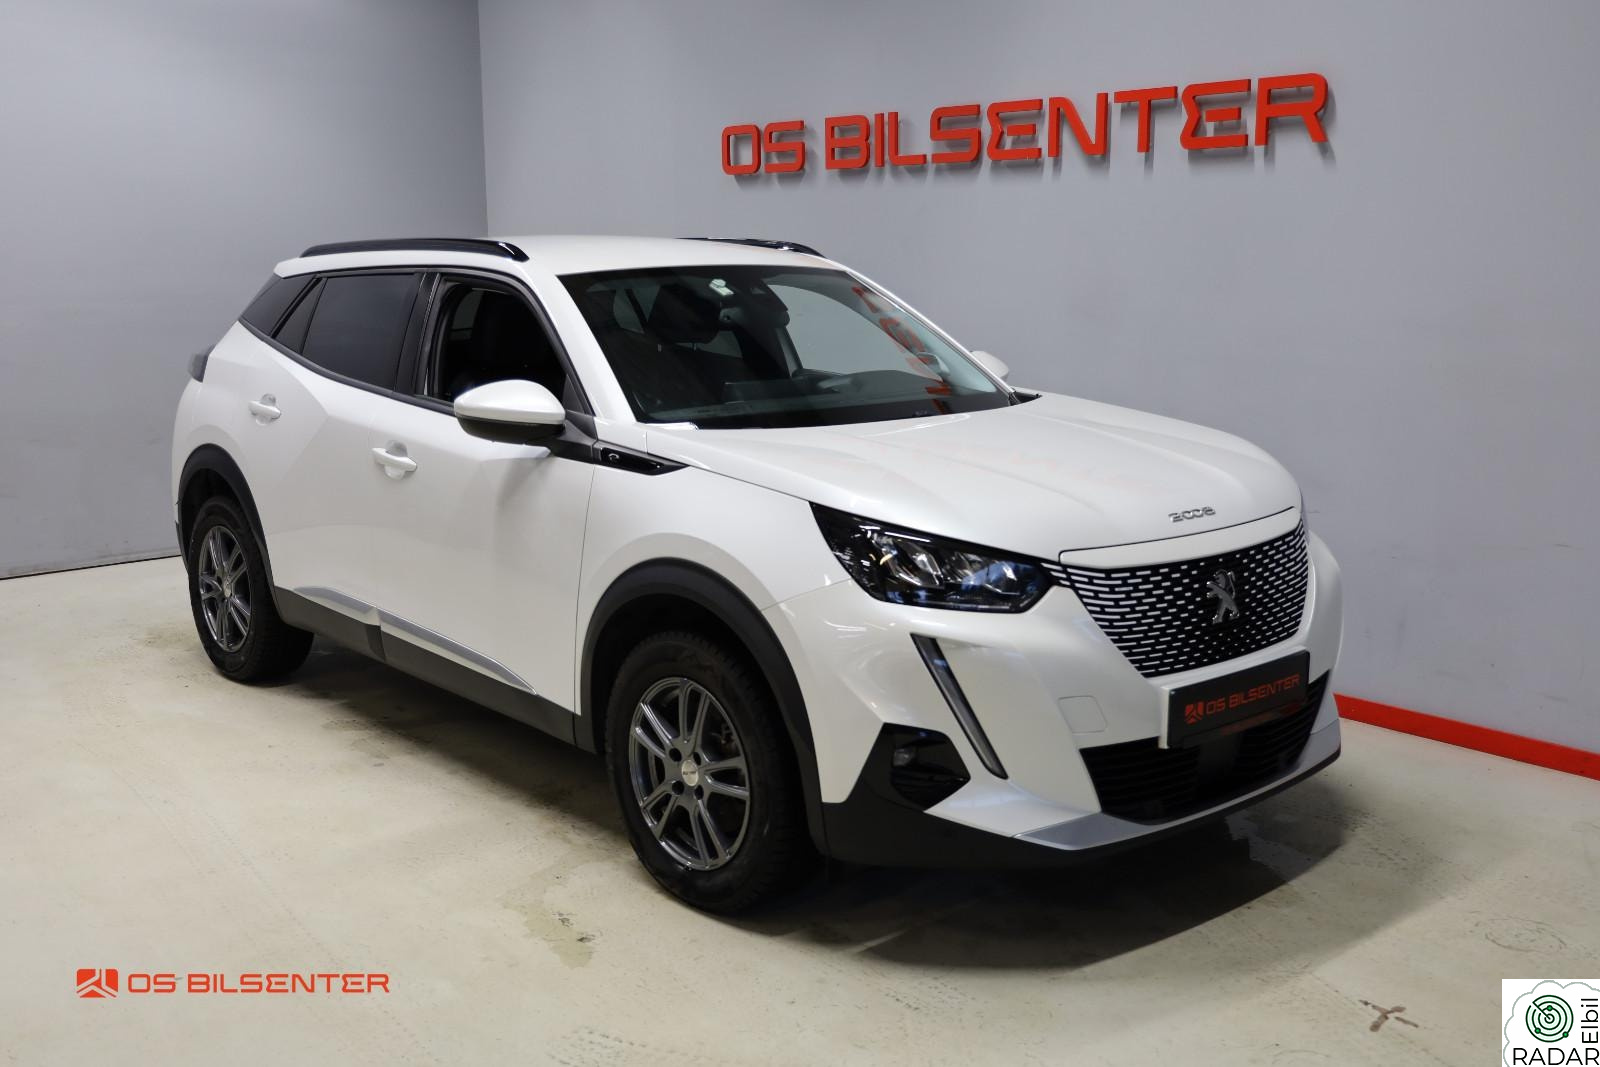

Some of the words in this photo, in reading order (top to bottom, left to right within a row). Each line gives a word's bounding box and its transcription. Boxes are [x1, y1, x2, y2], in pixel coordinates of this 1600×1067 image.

[721, 119, 806, 175] OS
[824, 71, 1329, 170] BILSENTER
[1168, 506, 1217, 523] 2008
[1206, 697, 1226, 715] OS
[1228, 673, 1300, 709] BILSENTER
